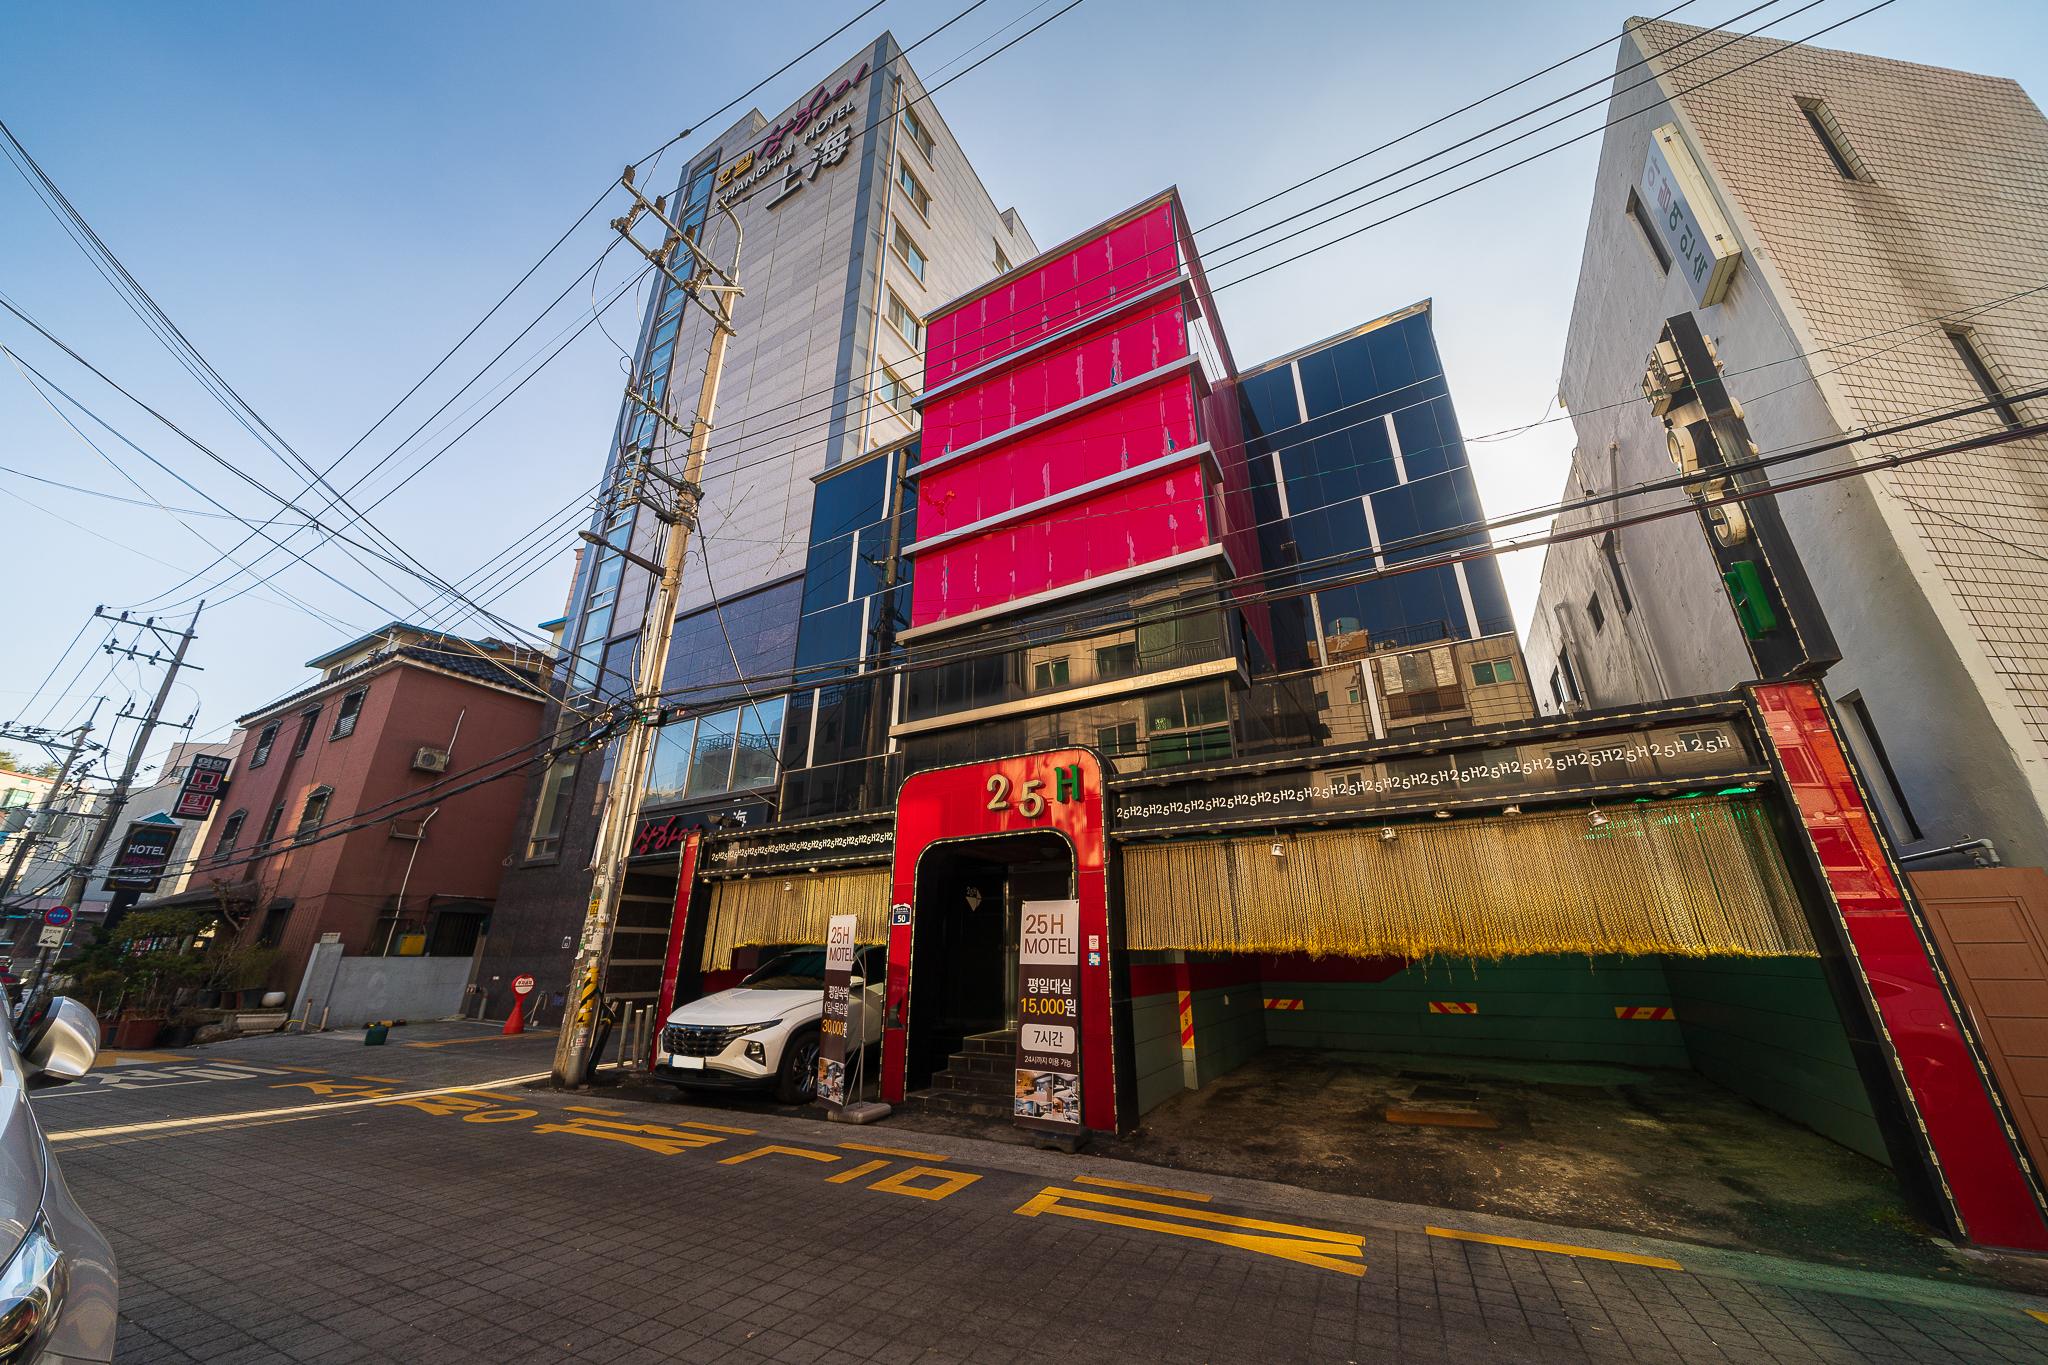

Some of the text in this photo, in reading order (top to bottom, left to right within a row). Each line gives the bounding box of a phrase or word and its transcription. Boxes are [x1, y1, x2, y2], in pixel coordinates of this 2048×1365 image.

[803, 100, 856, 144] HOTEL
[715, 149, 756, 193] 호텔
[176, 768, 223, 816] 모텔
[985, 764, 1082, 819] 25H
[127, 844, 166, 856] HOTEL
[897, 914, 906, 923] 50
[1025, 913, 1064, 935] 25H
[831, 926, 850, 944] 25H
[829, 947, 854, 962] MOTEL
[1024, 937, 1076, 955] MOTEL
[1027, 977, 1072, 995] 평일대실
[1020, 998, 1077, 1017] 15,000원
[1033, 1030, 1064, 1048] 7시간
